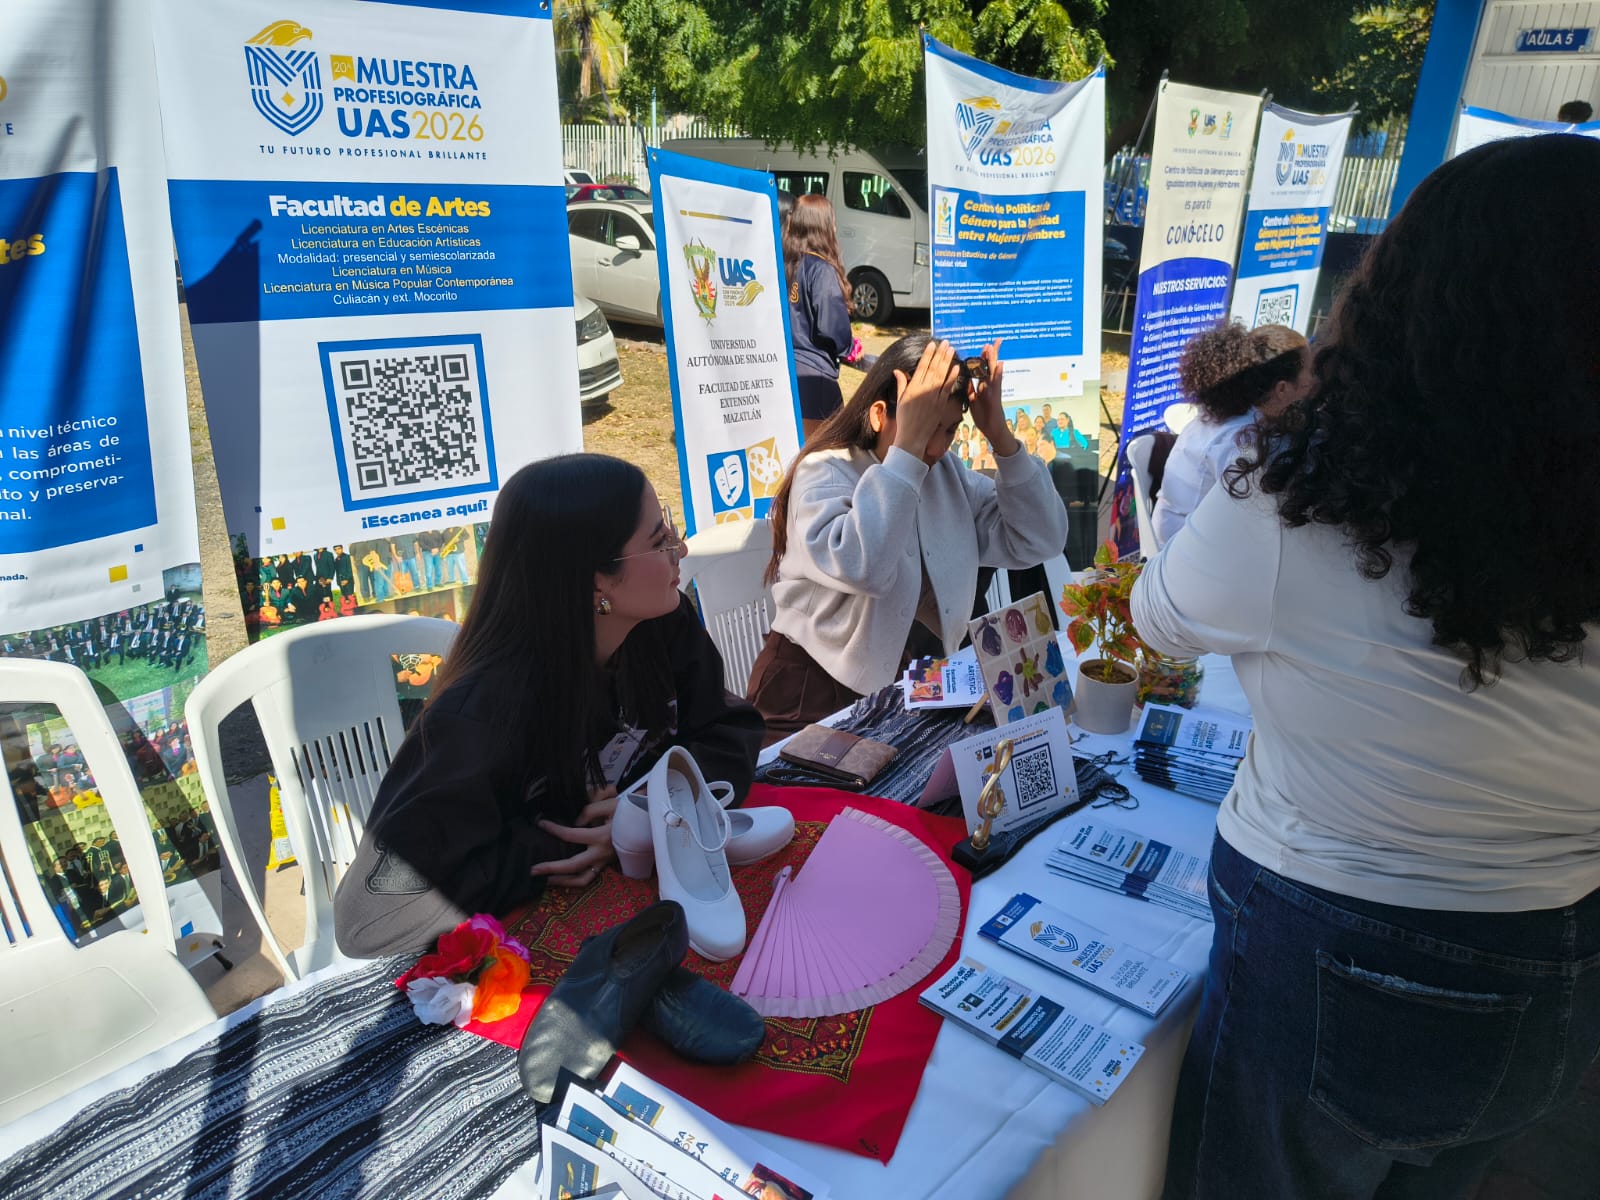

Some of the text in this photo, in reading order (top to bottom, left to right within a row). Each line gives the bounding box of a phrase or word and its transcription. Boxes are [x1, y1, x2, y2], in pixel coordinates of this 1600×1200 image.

[1527, 33, 1574, 45] AULA 5
[357, 56, 478, 90] MUESTRA
[333, 87, 481, 109] PROFESIOGRÁFICA
[260, 145, 487, 160] TU FUTURO PROFESIONAL BRILLANTE
[1292, 169, 1309, 185] UAS
[269, 195, 491, 217] Facultad de Artes
[301, 223, 469, 235] Licenciatura en Artes Escénicas
[960, 214, 1026, 230] Género para la
[291, 237, 481, 249] Licenciatura en Educación Artísticas
[958, 230, 984, 241] entre
[278, 250, 495, 264] Modalidad: presencial y semiescolarizada
[332, 264, 452, 277] Licenciatura en Música
[718, 257, 756, 287] UAS
[263, 282, 332, 294] Licenciatura
[352, 279, 390, 291] Música
[393, 278, 432, 290] Popular
[435, 276, 513, 288] Contemporánea
[333, 294, 380, 305] Culiacán
[392, 293, 411, 303] ext.
[414, 291, 457, 302] Mocorito
[710, 339, 757, 350] UNIVERSIDAD
[687, 352, 778, 368] AUTÓNOMA DE SINALOA
[699, 379, 774, 395] FACULTAD DE ARTES
[719, 393, 760, 409] EXTENSIÓN
[723, 408, 762, 424] MAZATLÁN
[8, 416, 118, 439] nivel técnico
[13, 435, 120, 460] las áreas de
[9, 453, 122, 481] comprometi-
[29, 490, 40, 502] y
[46, 474, 124, 500] preserva-
[361, 500, 488, 529] ¡Escanea aquí!
[1076, 940, 1100, 963] MUESTRA
[1086, 959, 1103, 974] UAS
[1116, 960, 1144, 989] PROFESIONAL
